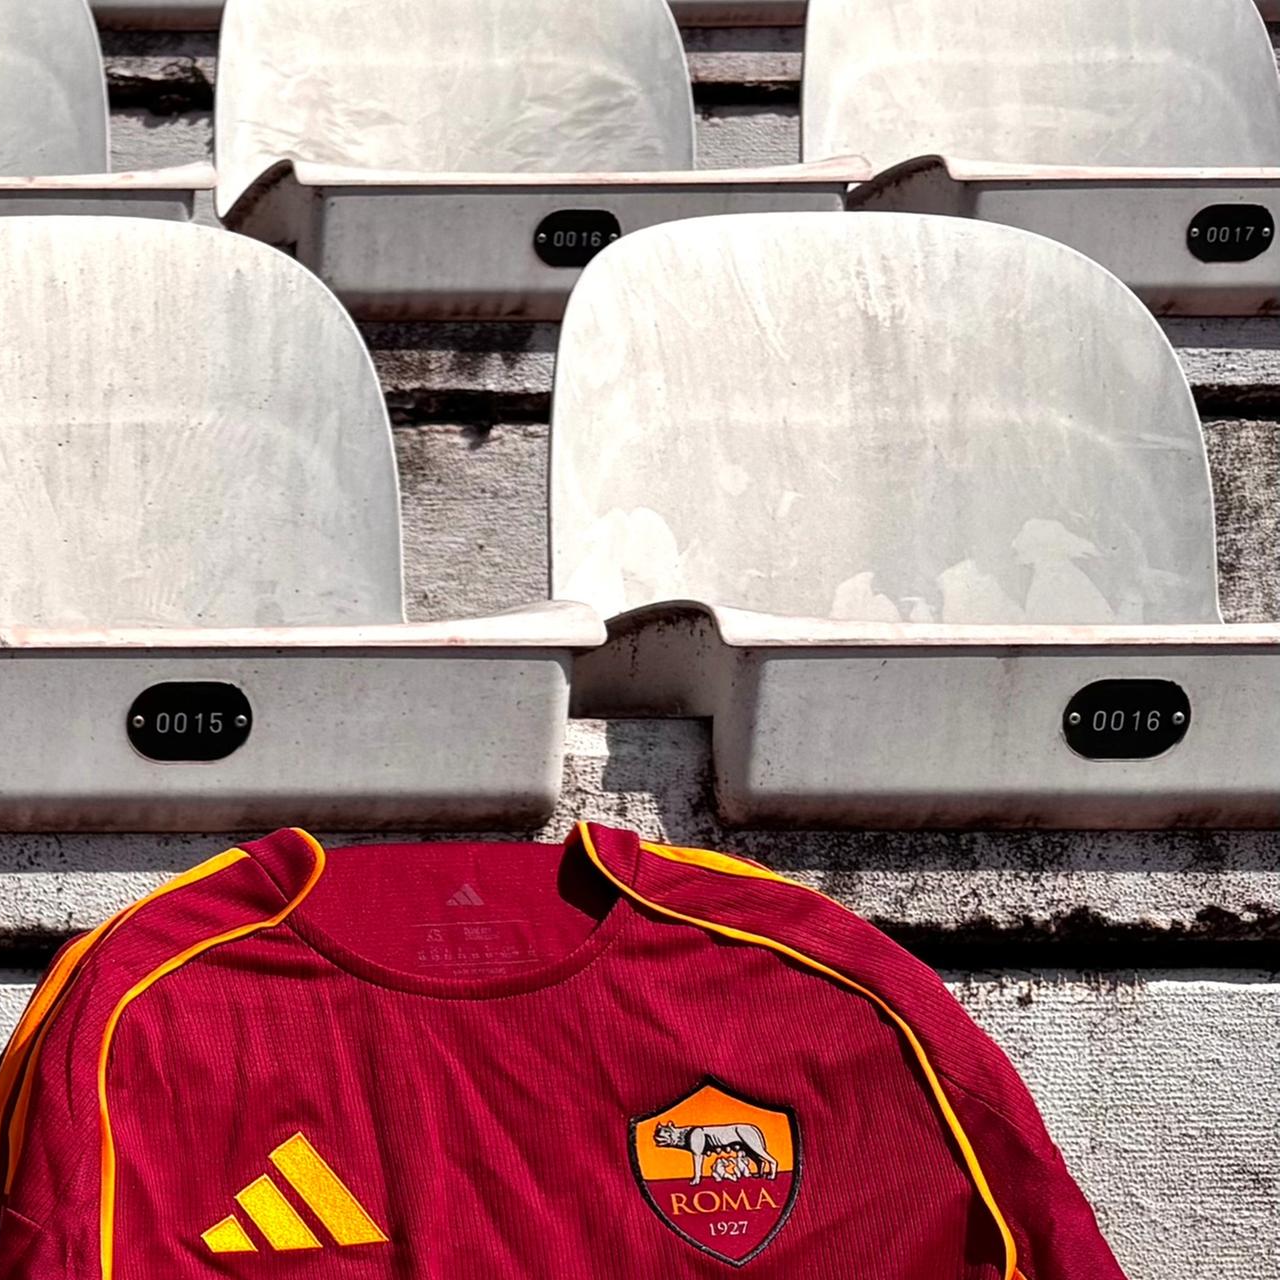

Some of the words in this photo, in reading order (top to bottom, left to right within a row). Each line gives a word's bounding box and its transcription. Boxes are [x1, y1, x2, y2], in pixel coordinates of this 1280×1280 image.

[552, 230, 602, 247] 0016
[1206, 226, 1255, 243] 0017
[156, 712, 224, 734] 0015
[1092, 709, 1161, 732] 0016
[670, 1187, 781, 1216] ROMA
[709, 1220, 749, 1237] 1927
